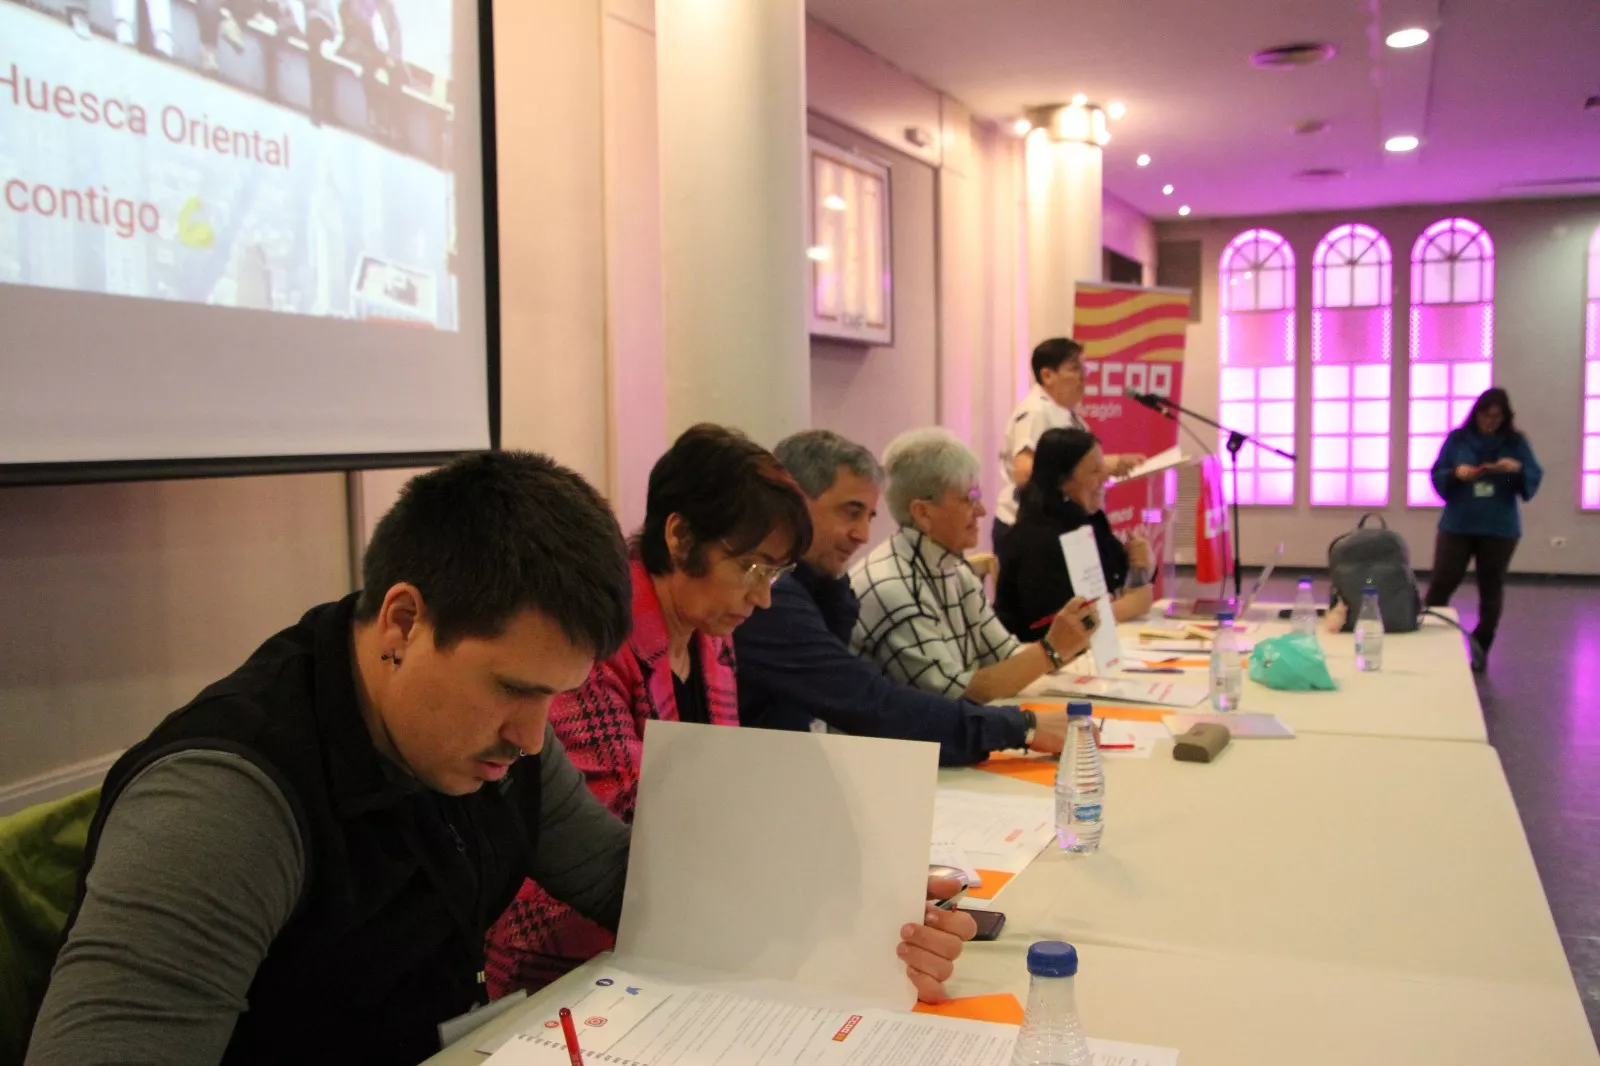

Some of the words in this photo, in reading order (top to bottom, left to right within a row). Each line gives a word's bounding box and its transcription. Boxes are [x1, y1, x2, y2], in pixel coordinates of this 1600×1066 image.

[0, 63, 147, 136] Huesca
[161, 104, 290, 170] Oriental
[4, 178, 160, 239] contigo
